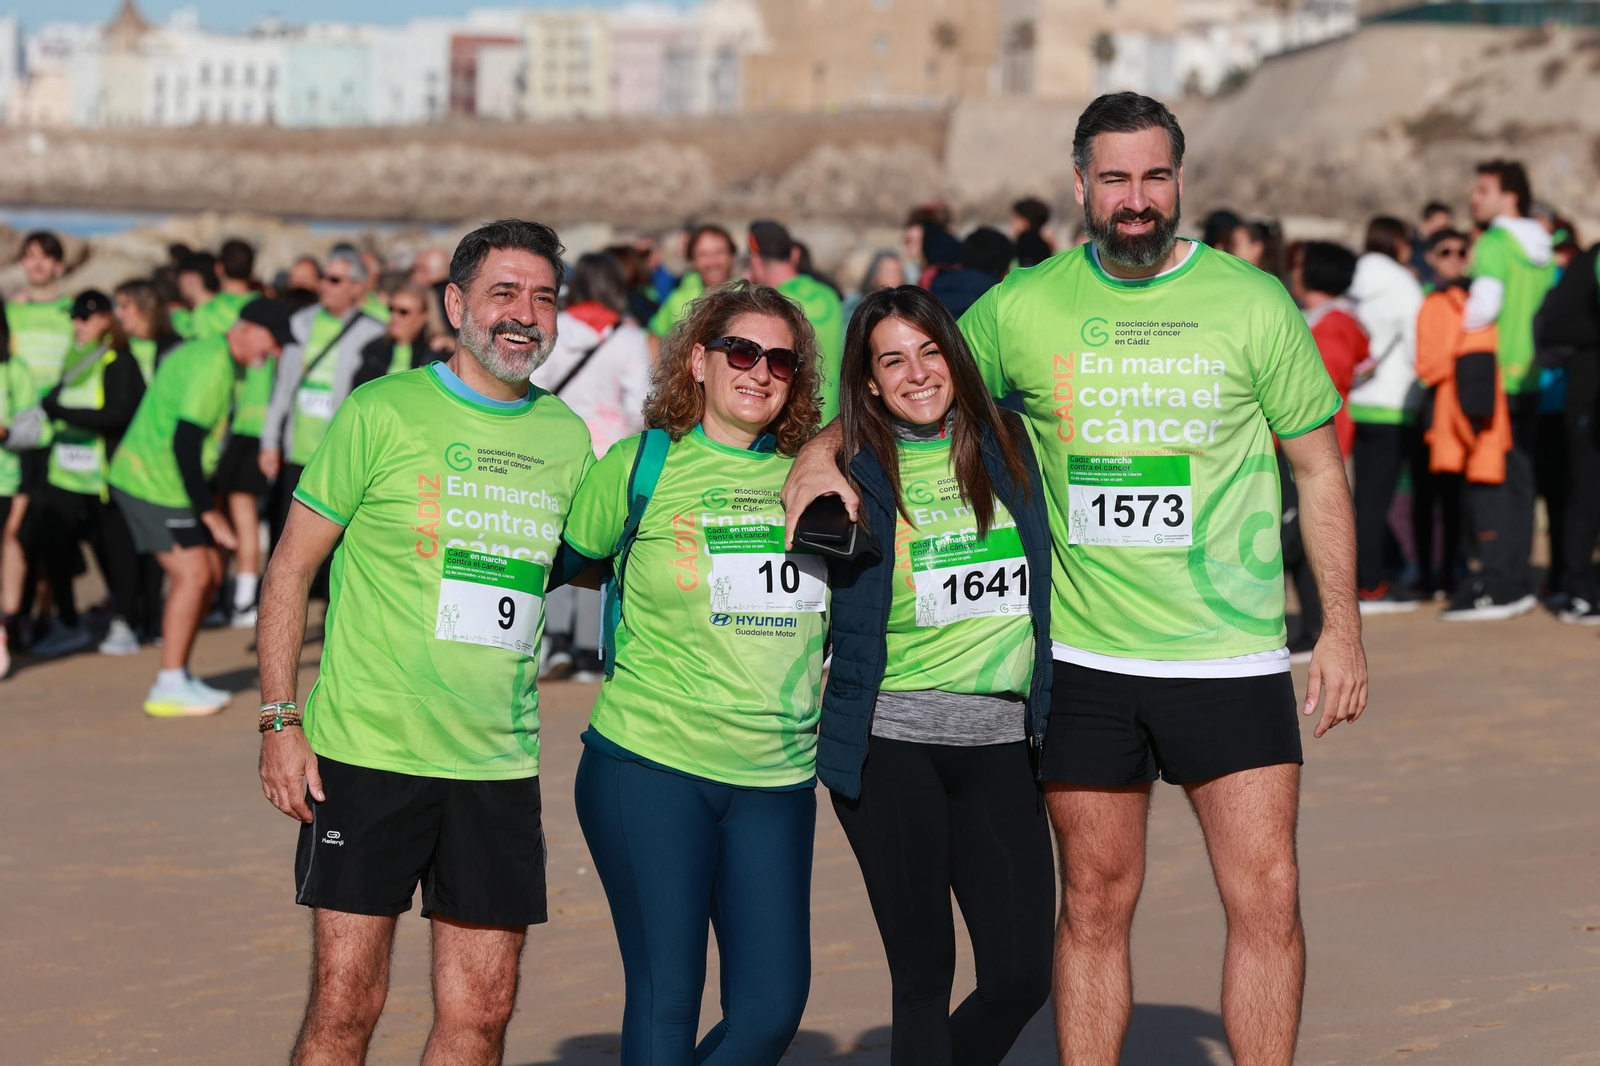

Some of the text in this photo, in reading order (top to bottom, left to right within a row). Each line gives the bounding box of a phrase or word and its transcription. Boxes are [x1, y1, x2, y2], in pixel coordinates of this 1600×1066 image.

[1161, 321, 1199, 330] española
[1080, 352, 1226, 375] En marcha
[1052, 352, 1075, 442] CÁDIZ
[1078, 382, 1222, 408] contra el
[1081, 410, 1223, 444] cáncer
[478, 448, 545, 465] asociación española
[478, 456, 502, 464] contra
[510, 460, 532, 470] cáncer
[489, 466, 508, 475] Cádiz
[447, 475, 560, 514] En marcha
[734, 488, 772, 496] asociación
[410, 473, 441, 559] CÁDIZ
[701, 512, 734, 527] En
[914, 508, 948, 526] En
[1092, 494, 1185, 528] 1573
[446, 508, 561, 543] contra el
[947, 535, 976, 544] marcha
[447, 558, 471, 566] contra
[481, 555, 508, 565] marcha
[670, 512, 699, 592] CÁDIZ
[759, 560, 800, 593] 10
[943, 564, 1027, 605] 1641
[498, 596, 516, 630] 9
[736, 616, 797, 628] HYUNDAI
